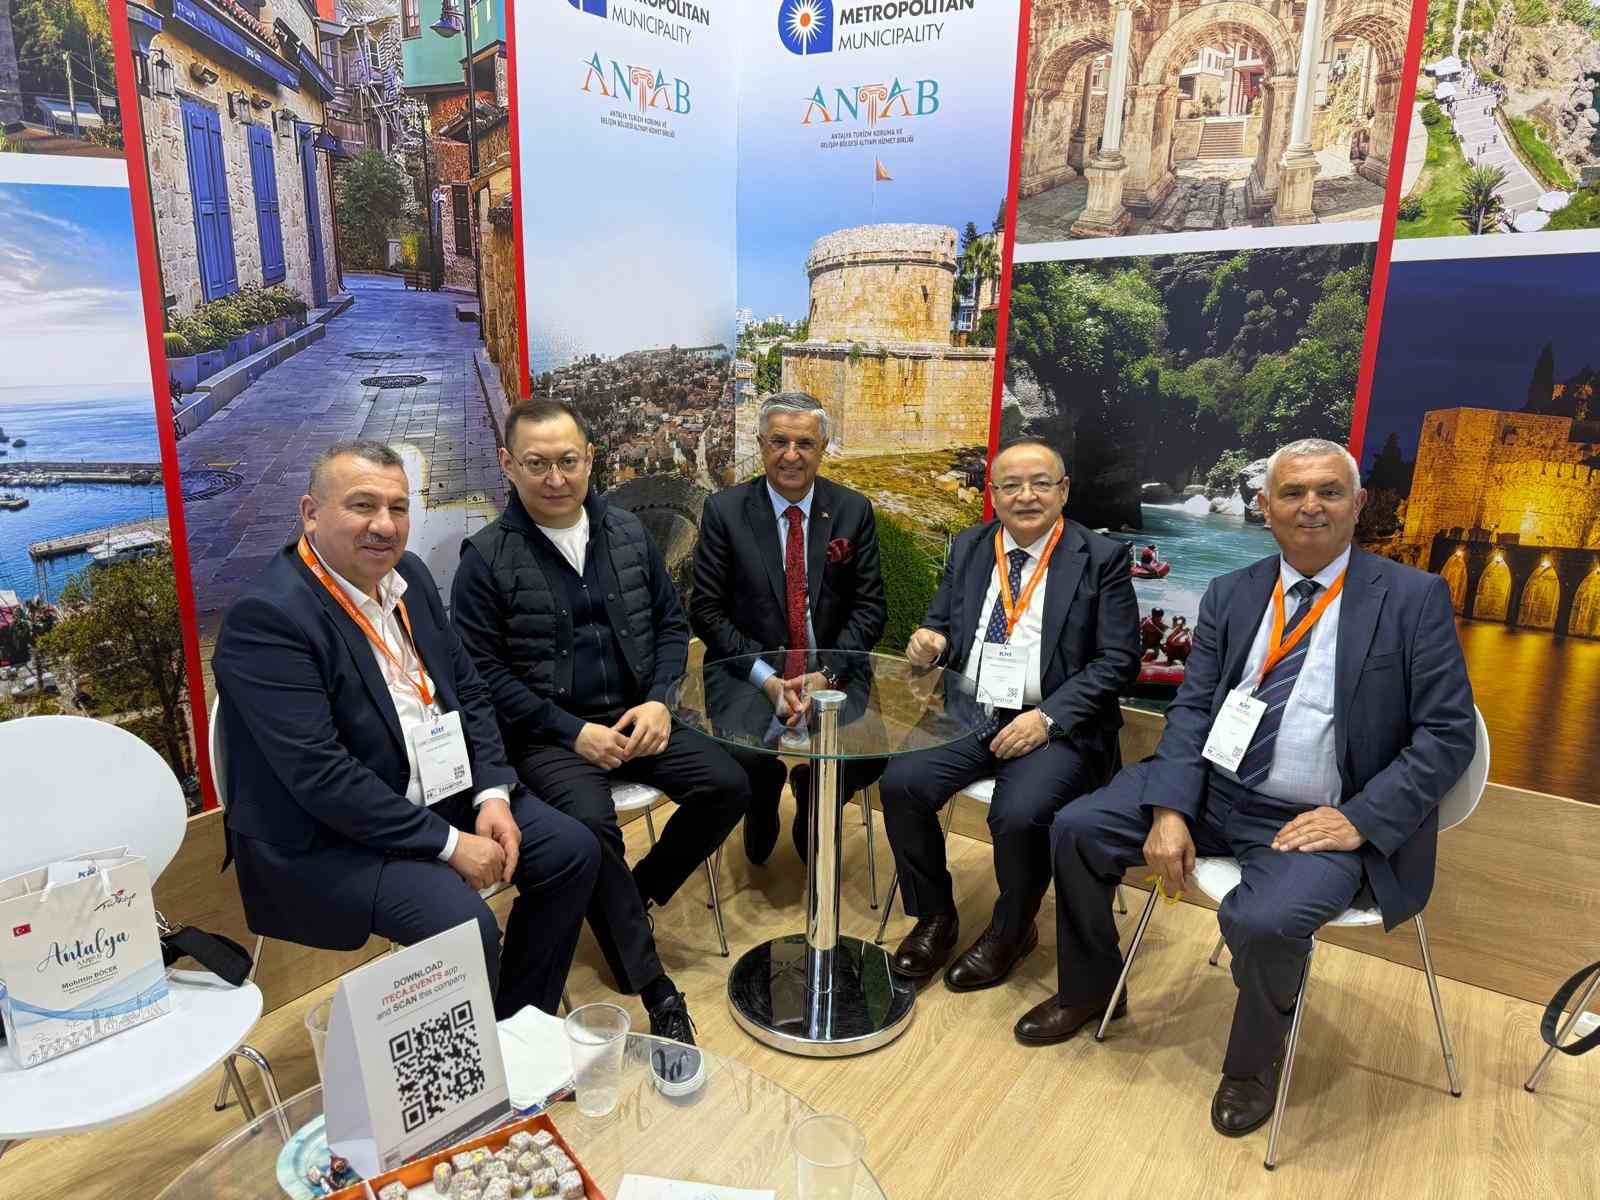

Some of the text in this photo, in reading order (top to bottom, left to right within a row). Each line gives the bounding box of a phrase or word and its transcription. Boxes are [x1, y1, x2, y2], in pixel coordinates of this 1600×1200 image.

[612, 4, 692, 44] MUNICIPALITY
[840, 0, 975, 26] METROPOLITAN
[838, 22, 945, 51] MUNICIPALITY
[581, 51, 691, 114] ANTAB
[800, 77, 941, 129] ANTAB
[36, 928, 130, 973] Antalya
[382, 966, 458, 1006] ITECA.EVENTS app
[393, 960, 443, 989] DOWNLOAD
[377, 974, 466, 1020] and SCAN this company
